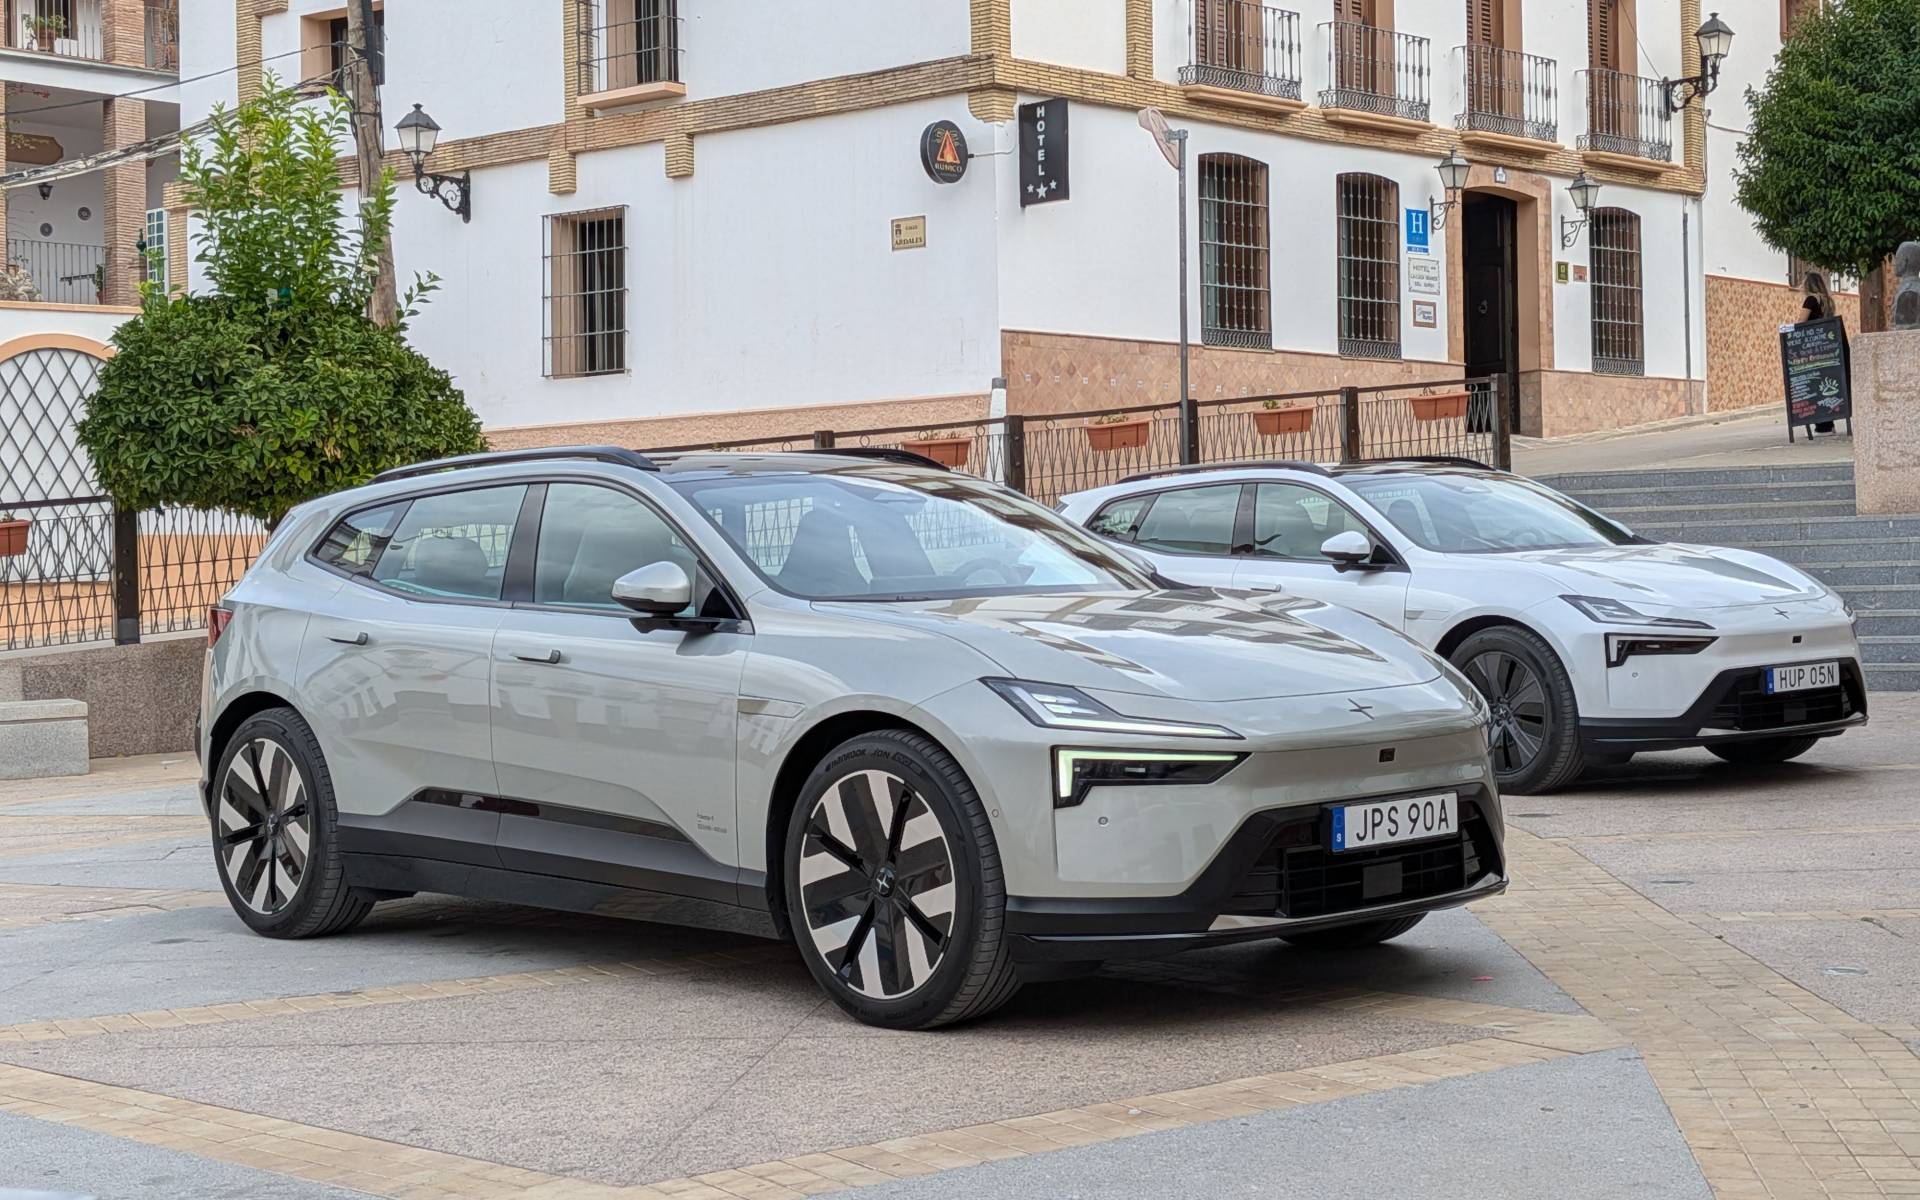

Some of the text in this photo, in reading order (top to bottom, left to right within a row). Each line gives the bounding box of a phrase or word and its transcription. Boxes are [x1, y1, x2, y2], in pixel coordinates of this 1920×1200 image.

[1036, 105, 1046, 176] HOTEL
[1410, 212, 1424, 235] H
[1779, 664, 1834, 689] HUP 05N
[1356, 798, 1450, 842] JPS 90A
